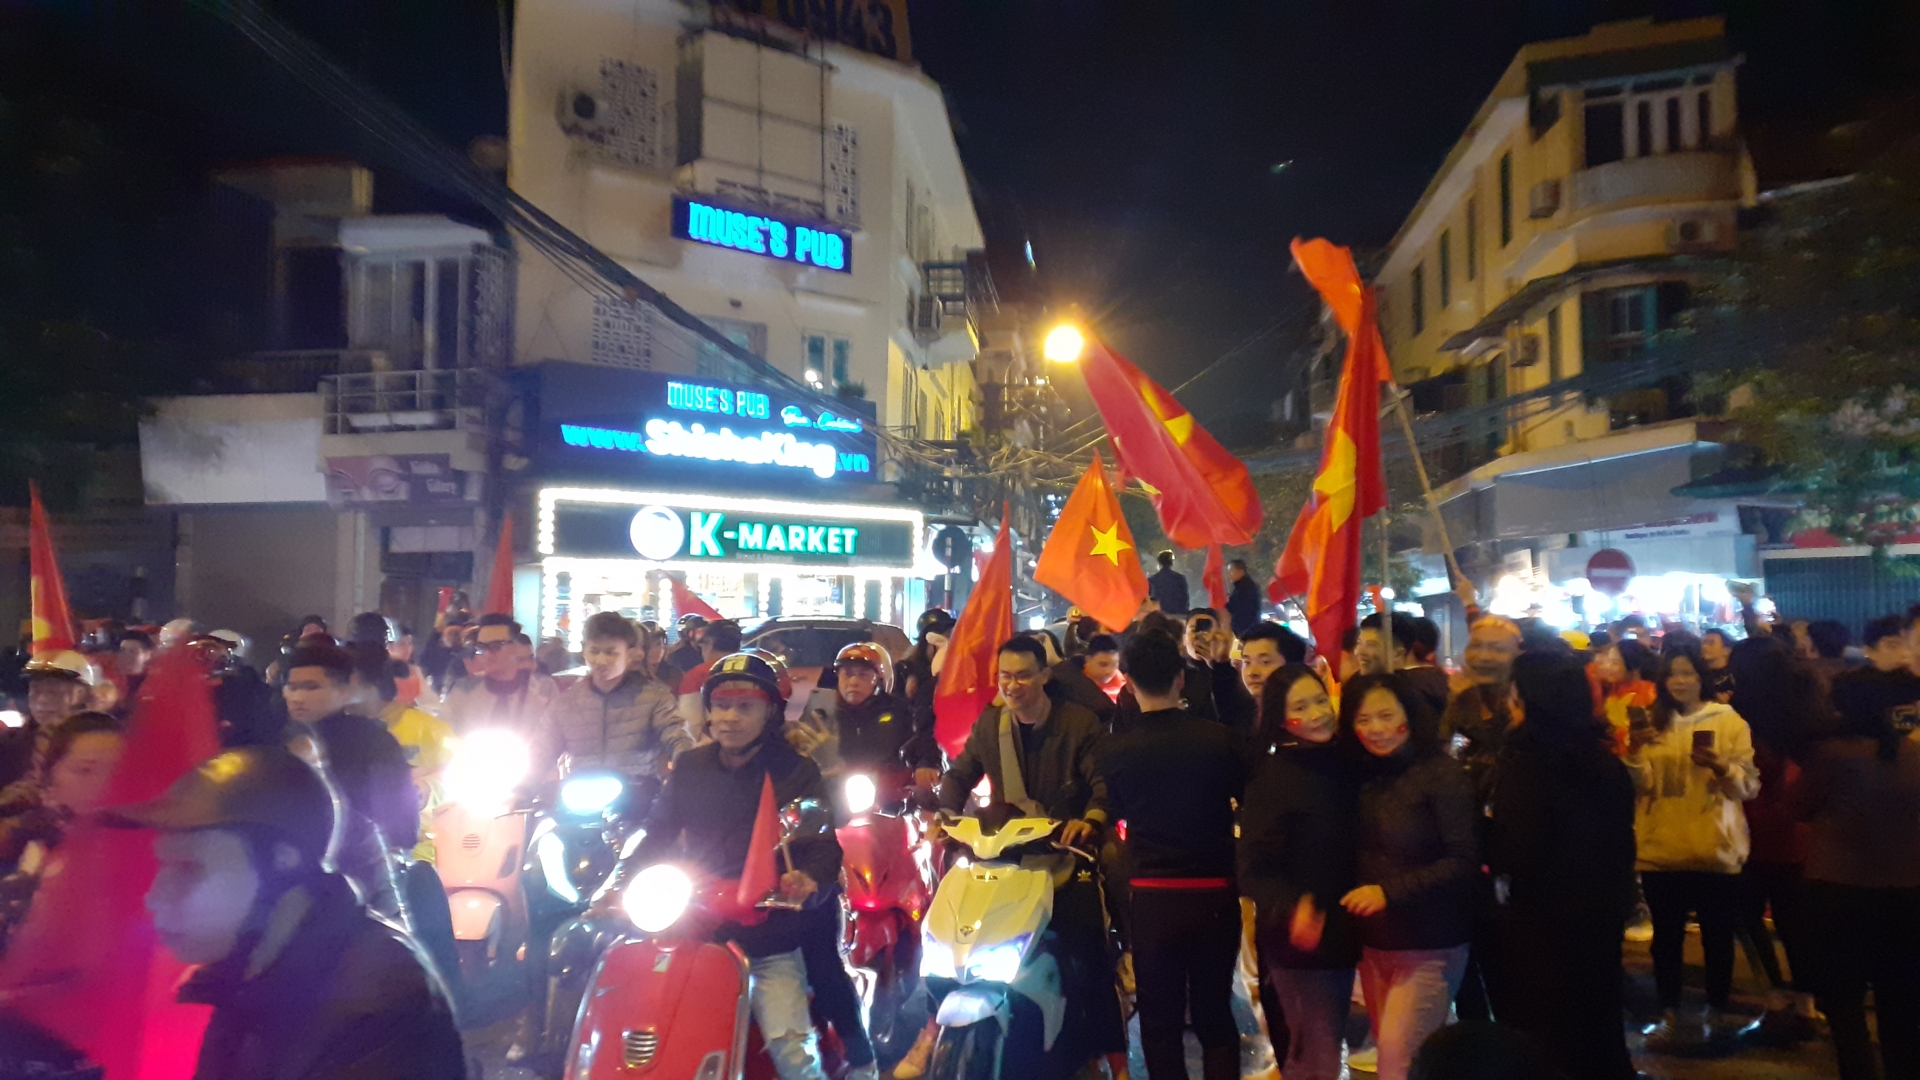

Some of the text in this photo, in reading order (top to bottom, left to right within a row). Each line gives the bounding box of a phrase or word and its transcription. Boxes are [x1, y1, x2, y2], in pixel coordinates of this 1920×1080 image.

[688, 201, 844, 269] MUSE'S PUB
[666, 381, 733, 415] MUSE'S
[736, 390, 770, 420] PUB
[689, 511, 859, 557] K-MARKET
